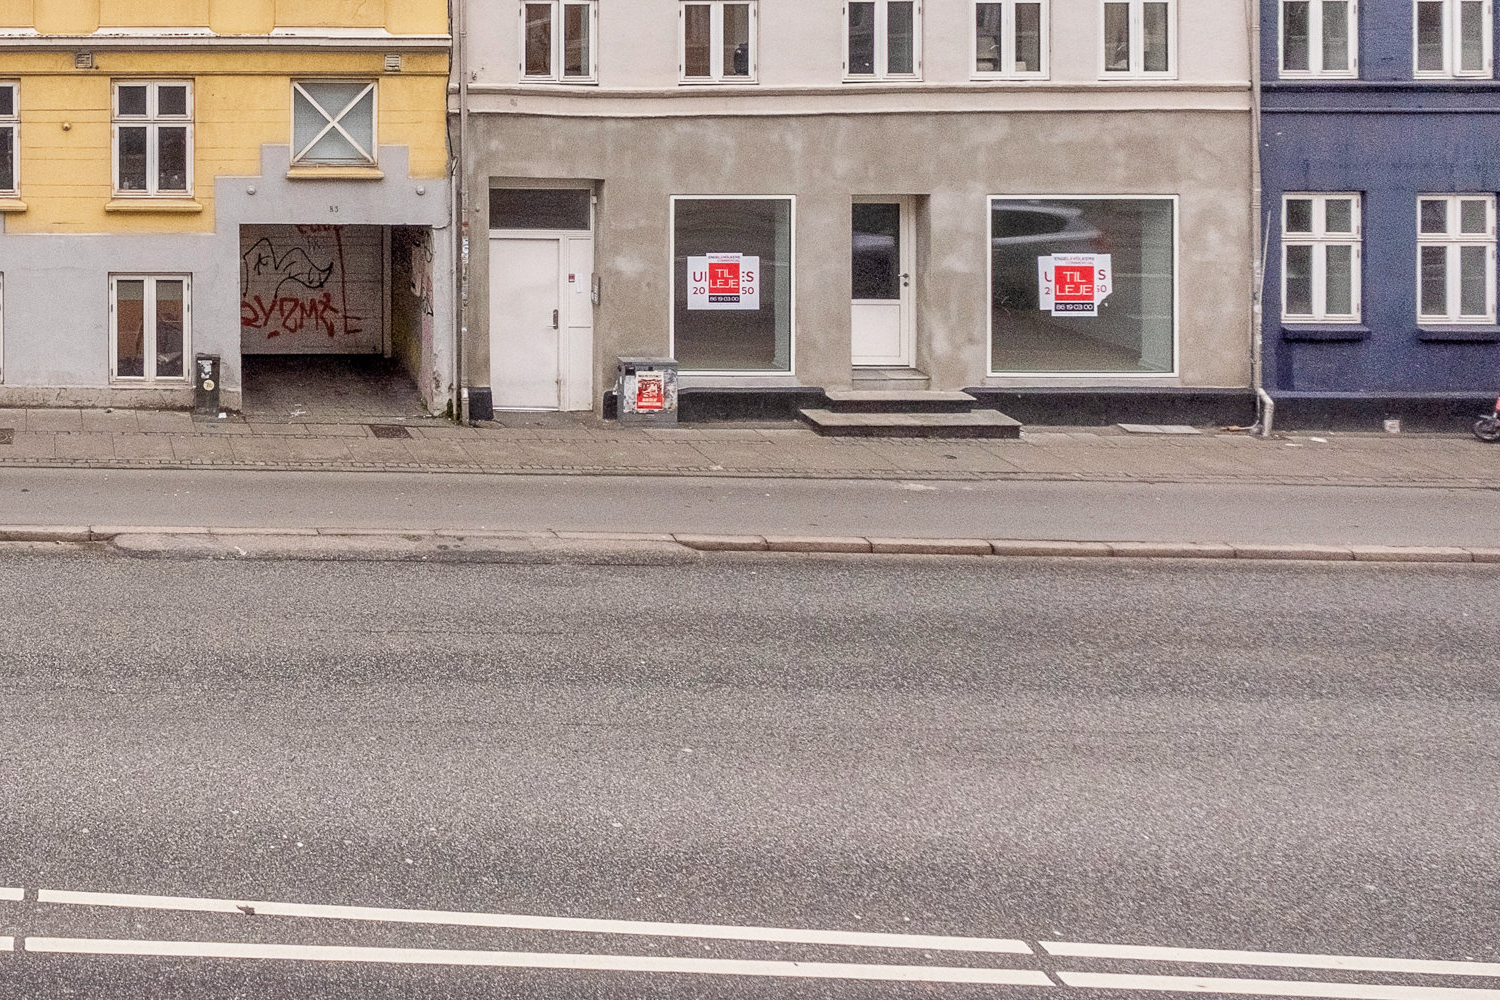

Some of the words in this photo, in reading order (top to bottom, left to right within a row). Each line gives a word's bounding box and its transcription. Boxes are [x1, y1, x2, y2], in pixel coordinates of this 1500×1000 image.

[715, 268, 734, 278] TIL
[1062, 271, 1087, 283] TIL
[709, 279, 739, 289] LEJE
[692, 286, 706, 295] 20
[741, 286, 755, 295] 50
[1056, 284, 1093, 296] LEJE
